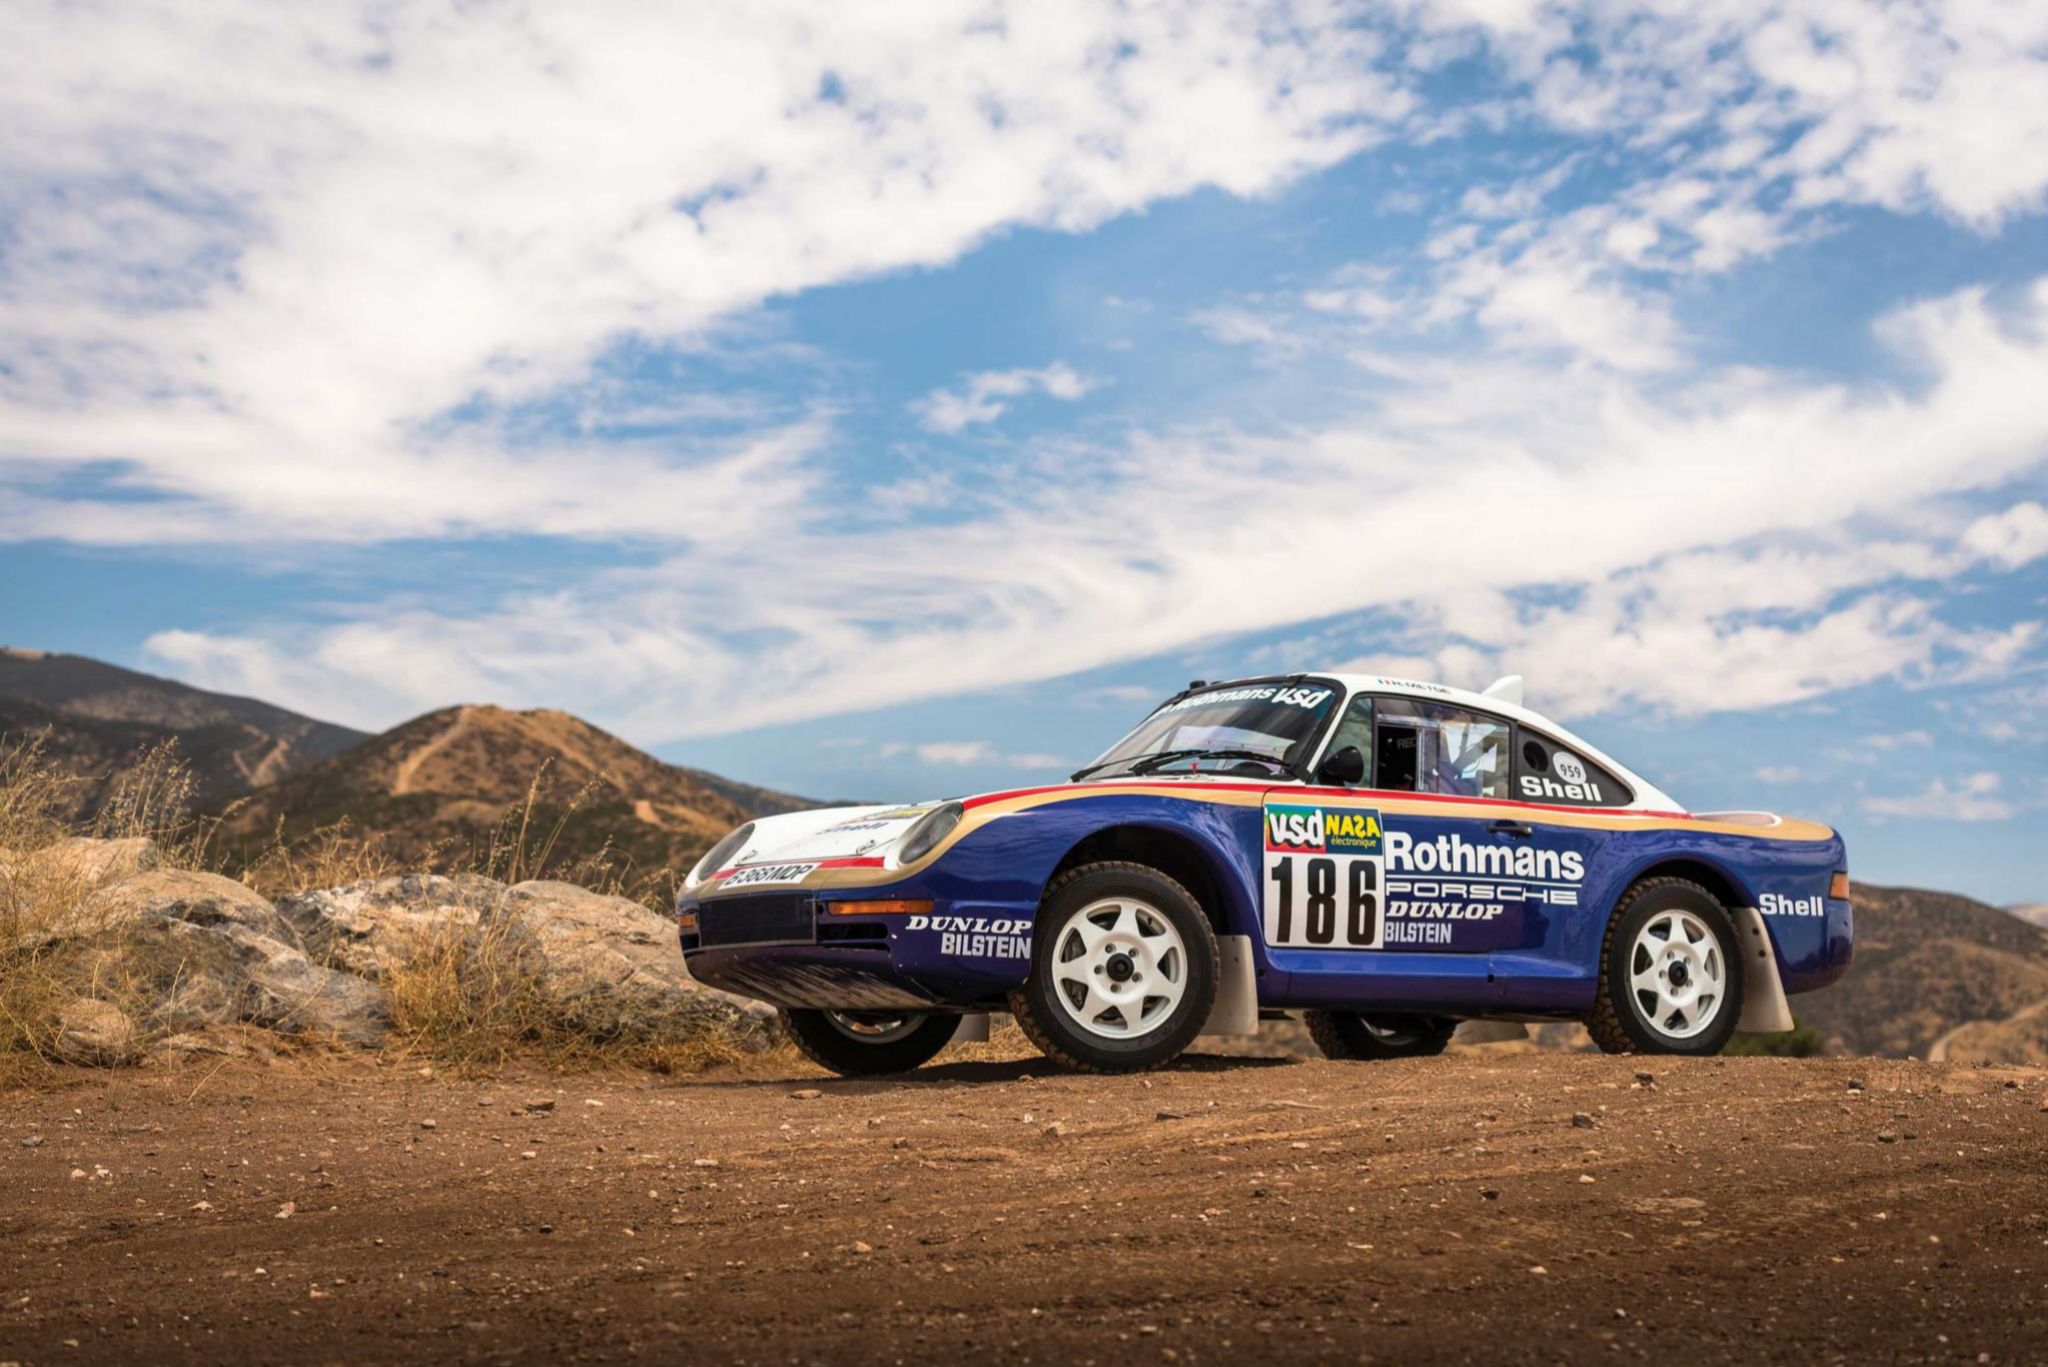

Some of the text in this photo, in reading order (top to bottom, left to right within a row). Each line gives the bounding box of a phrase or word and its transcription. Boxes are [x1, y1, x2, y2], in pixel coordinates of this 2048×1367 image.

[1560, 764, 1581, 779] 959
[1520, 775, 1602, 802] Shell
[1384, 831, 1585, 881] Rothmans
[1271, 856, 1377, 945] 186
[1385, 882, 1579, 905] PORSCHE
[1759, 893, 1824, 917] Shell
[1386, 900, 1504, 920] DUNLOP
[905, 915, 1033, 935] DUNLOP
[1384, 922, 1452, 944] BILSTEIN
[940, 932, 1032, 959] BILSTEIN
